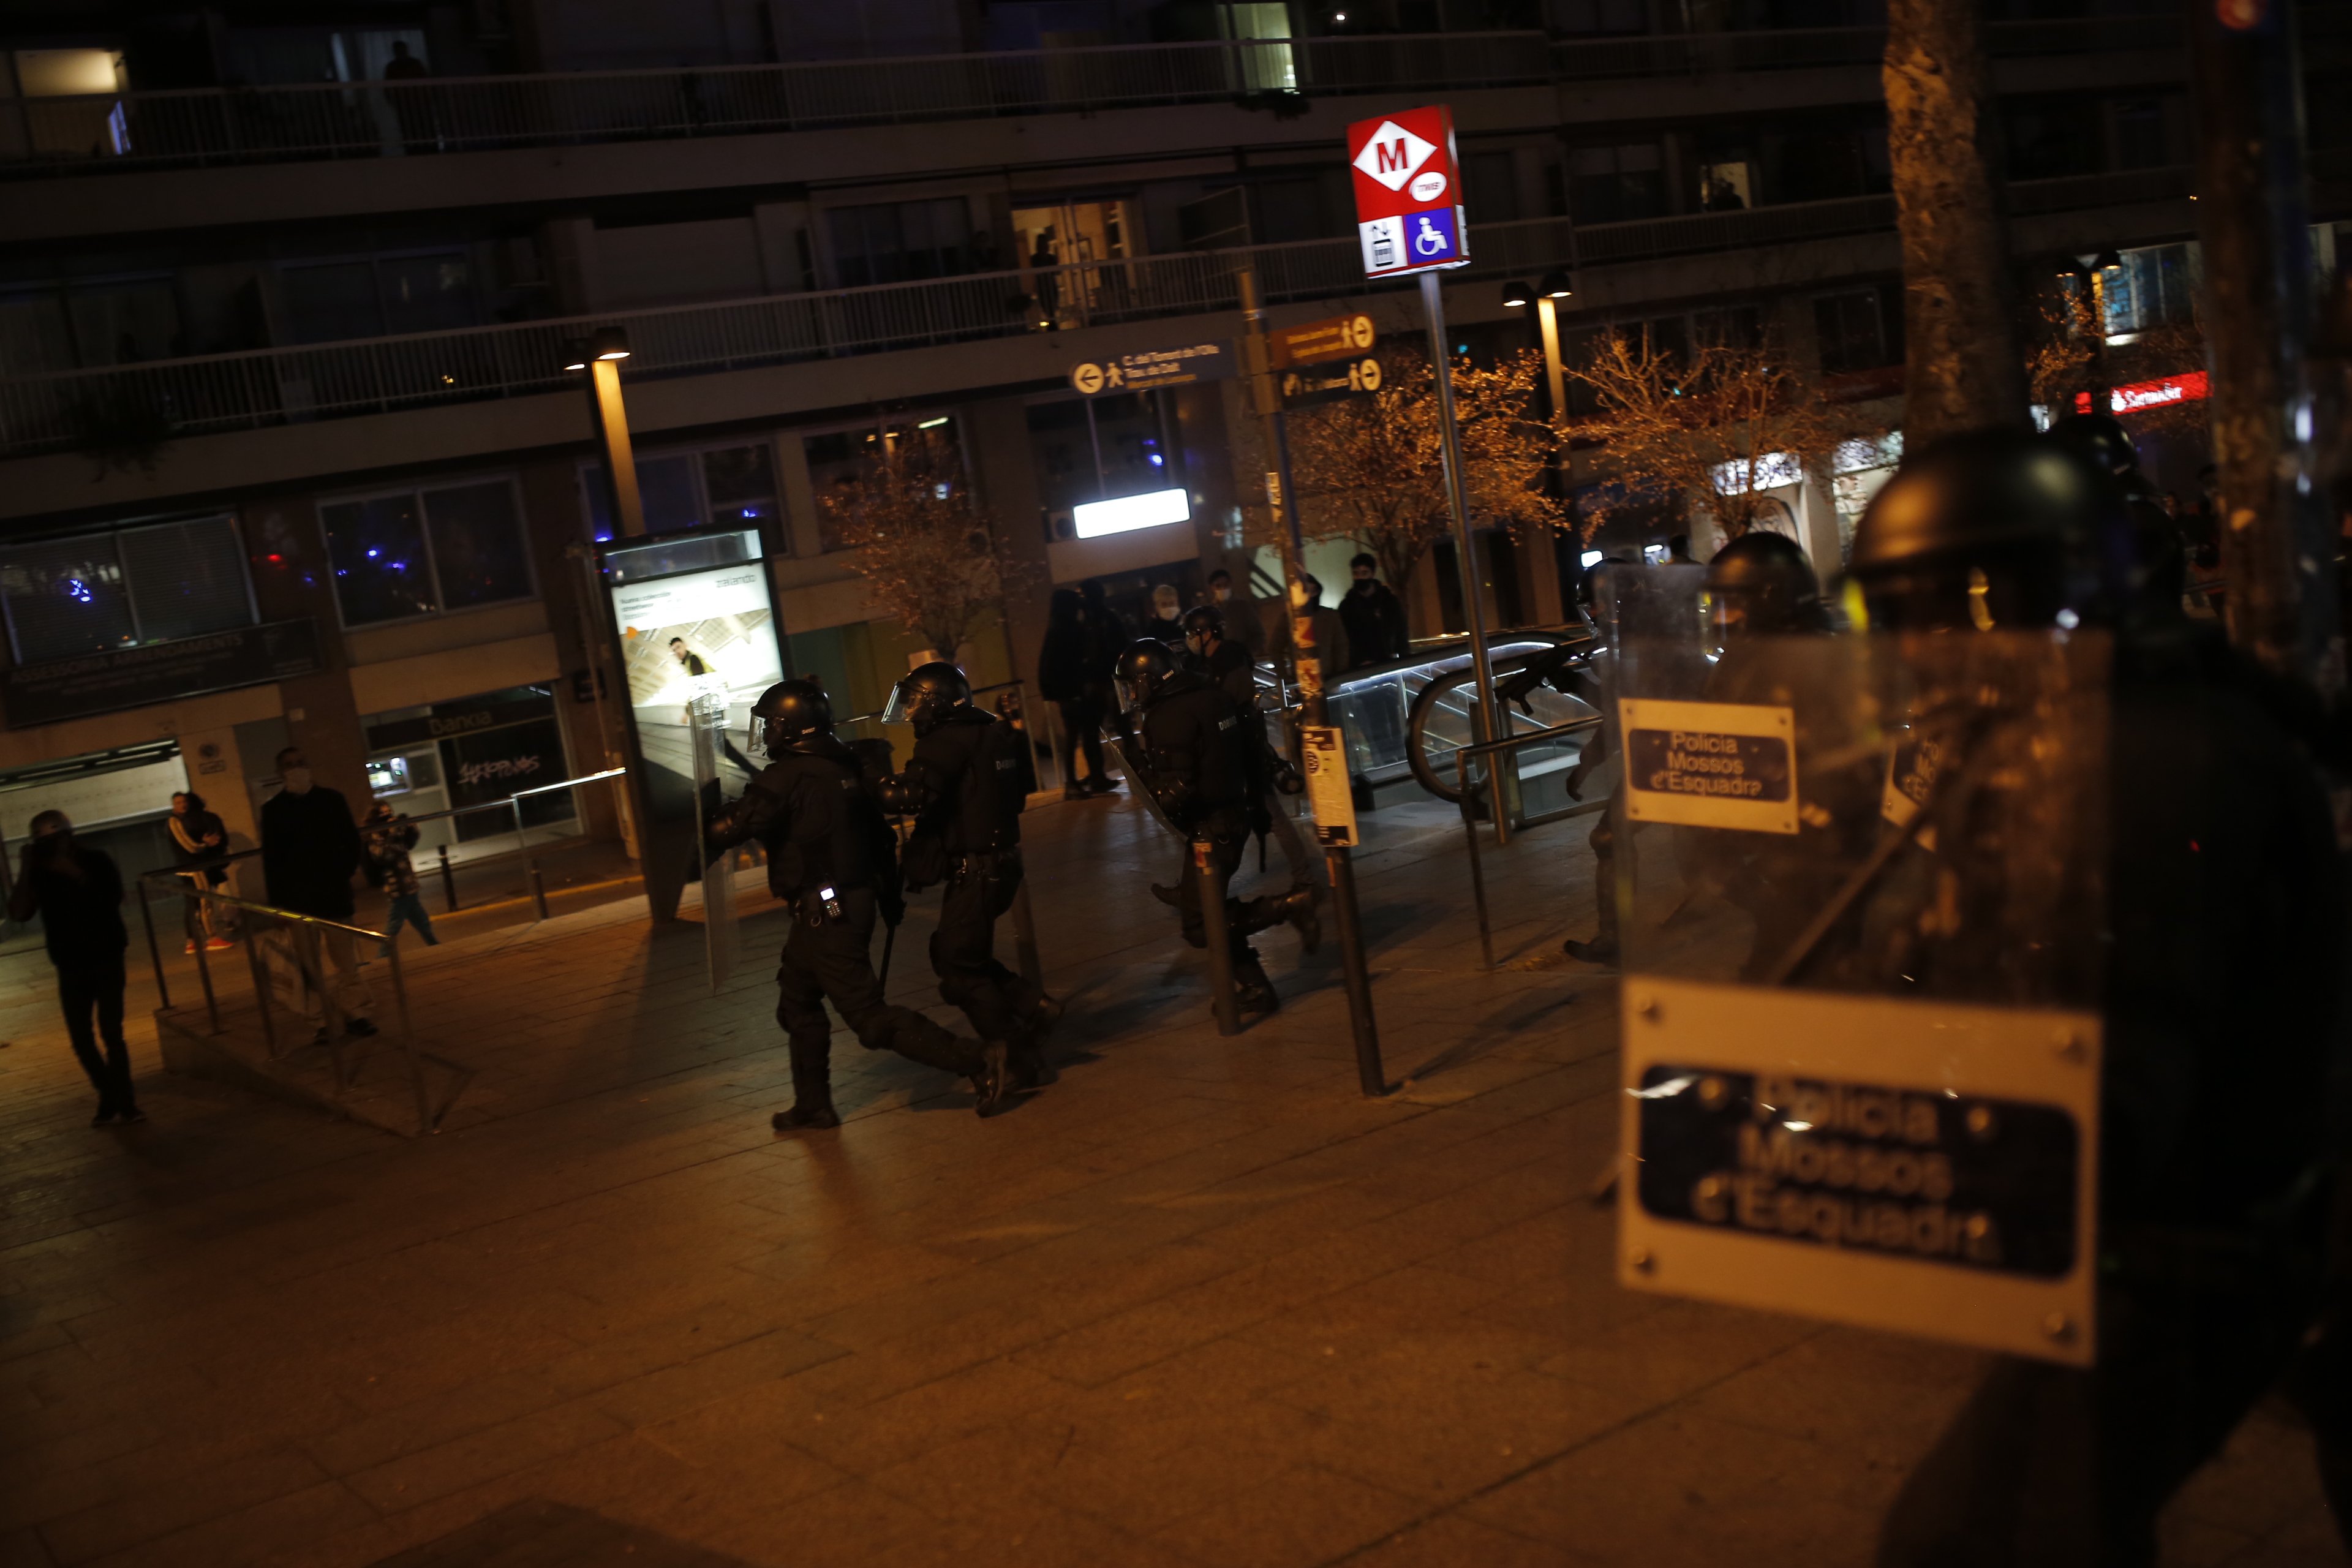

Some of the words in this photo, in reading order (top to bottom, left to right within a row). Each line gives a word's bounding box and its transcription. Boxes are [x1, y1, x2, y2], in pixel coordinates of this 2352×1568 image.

[1376, 138, 1408, 174] M
[429, 710, 494, 734] Bankia
[1670, 731, 1739, 754] Policia
[1666, 750, 1745, 775] Mossos
[1649, 769, 1763, 796] d'Esquadra
[1736, 1122, 1954, 1201] Mossos
